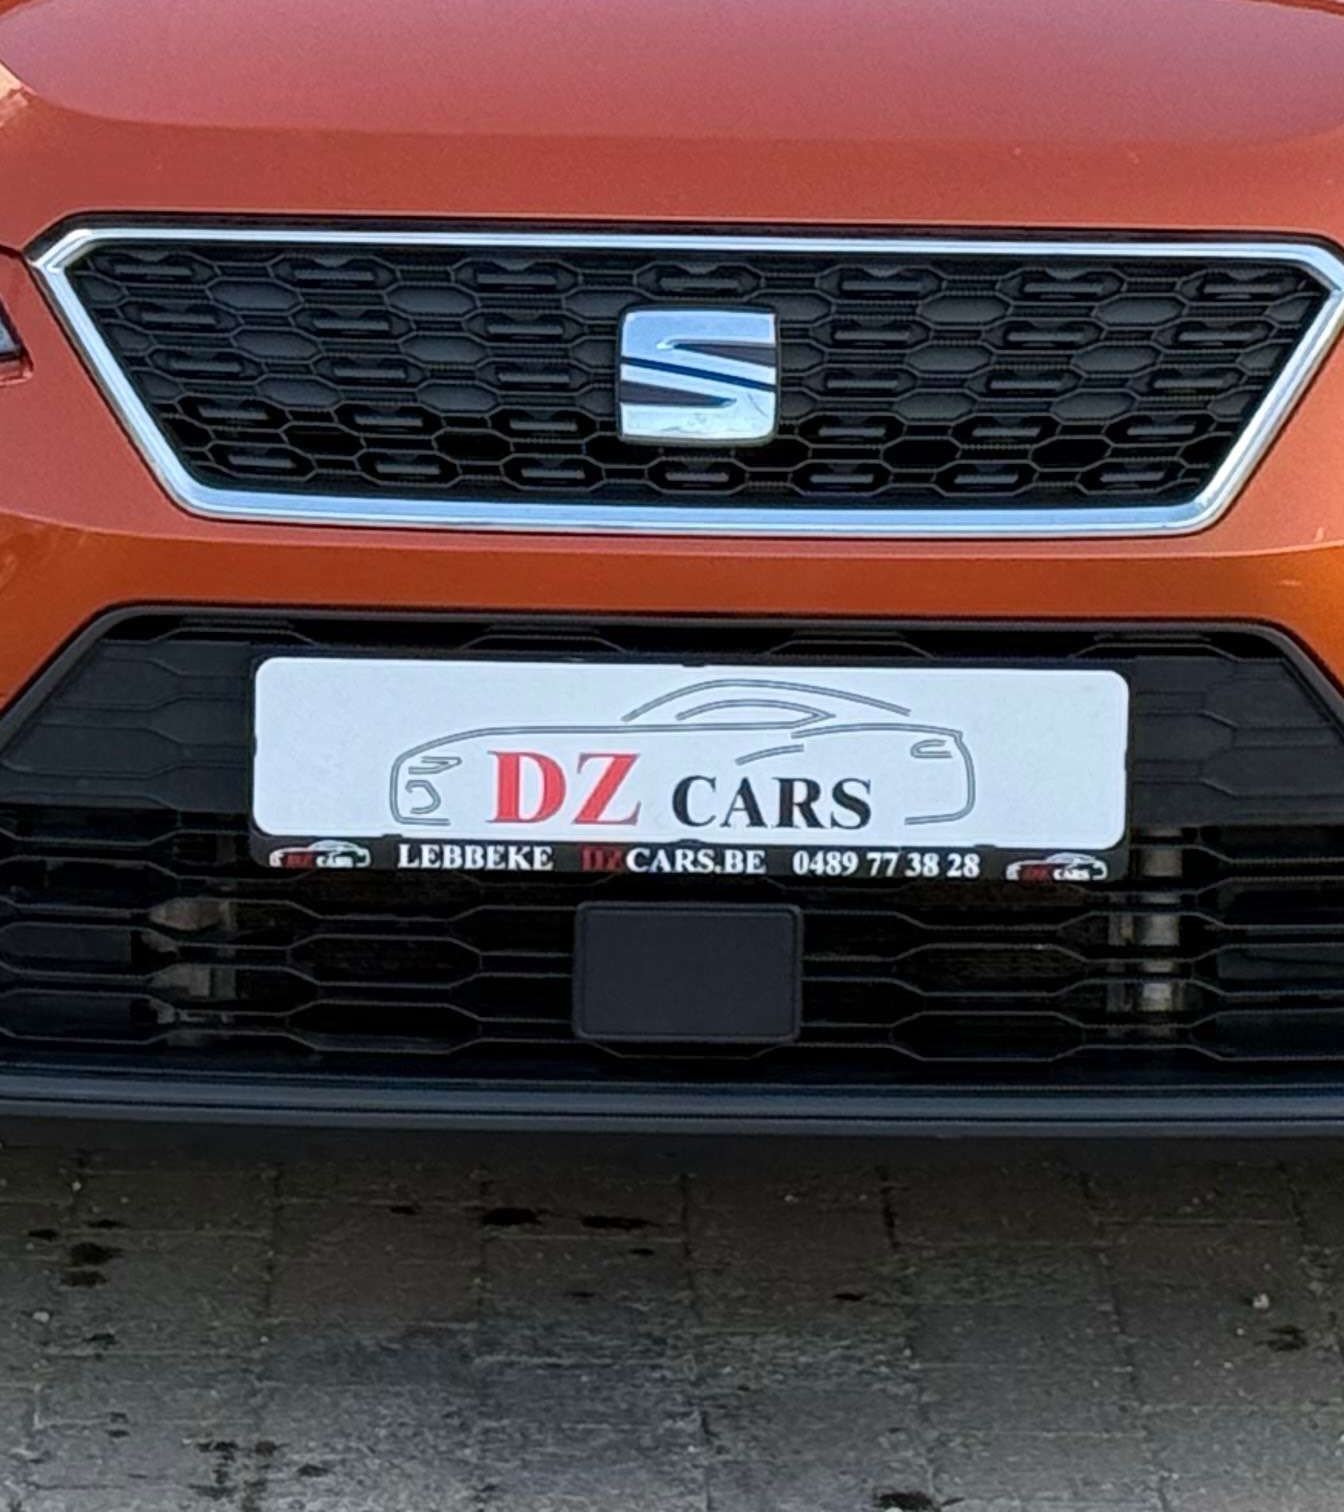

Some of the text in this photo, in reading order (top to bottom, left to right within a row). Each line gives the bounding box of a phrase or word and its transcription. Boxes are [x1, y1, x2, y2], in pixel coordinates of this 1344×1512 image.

[488, 749, 873, 831] DZ CARS
[397, 843, 554, 870] LEBBEKE
[792, 850, 858, 875] 0489
[867, 852, 900, 875] 77
[905, 852, 940, 876] 38
[949, 853, 981, 877] 28
